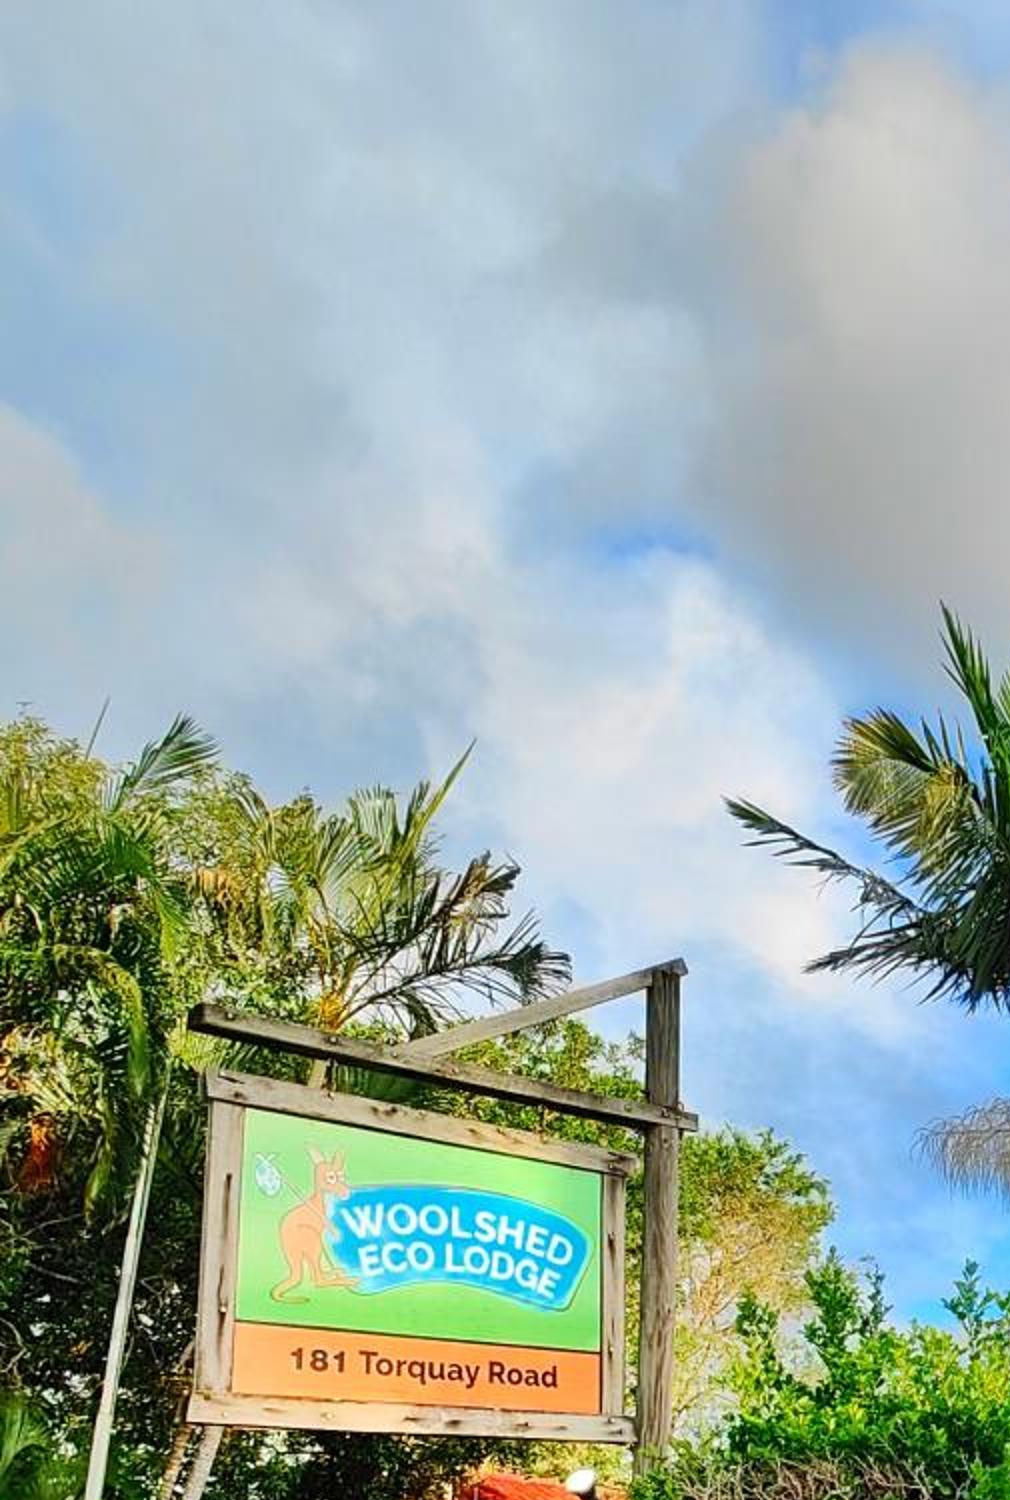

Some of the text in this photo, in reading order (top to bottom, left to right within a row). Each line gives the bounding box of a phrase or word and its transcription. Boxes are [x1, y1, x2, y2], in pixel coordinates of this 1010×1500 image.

[340, 1203, 574, 1266] WOOLSHED
[357, 1241, 561, 1299] ECO LODGE
[290, 1347, 559, 1389] 181 Torquay Road
